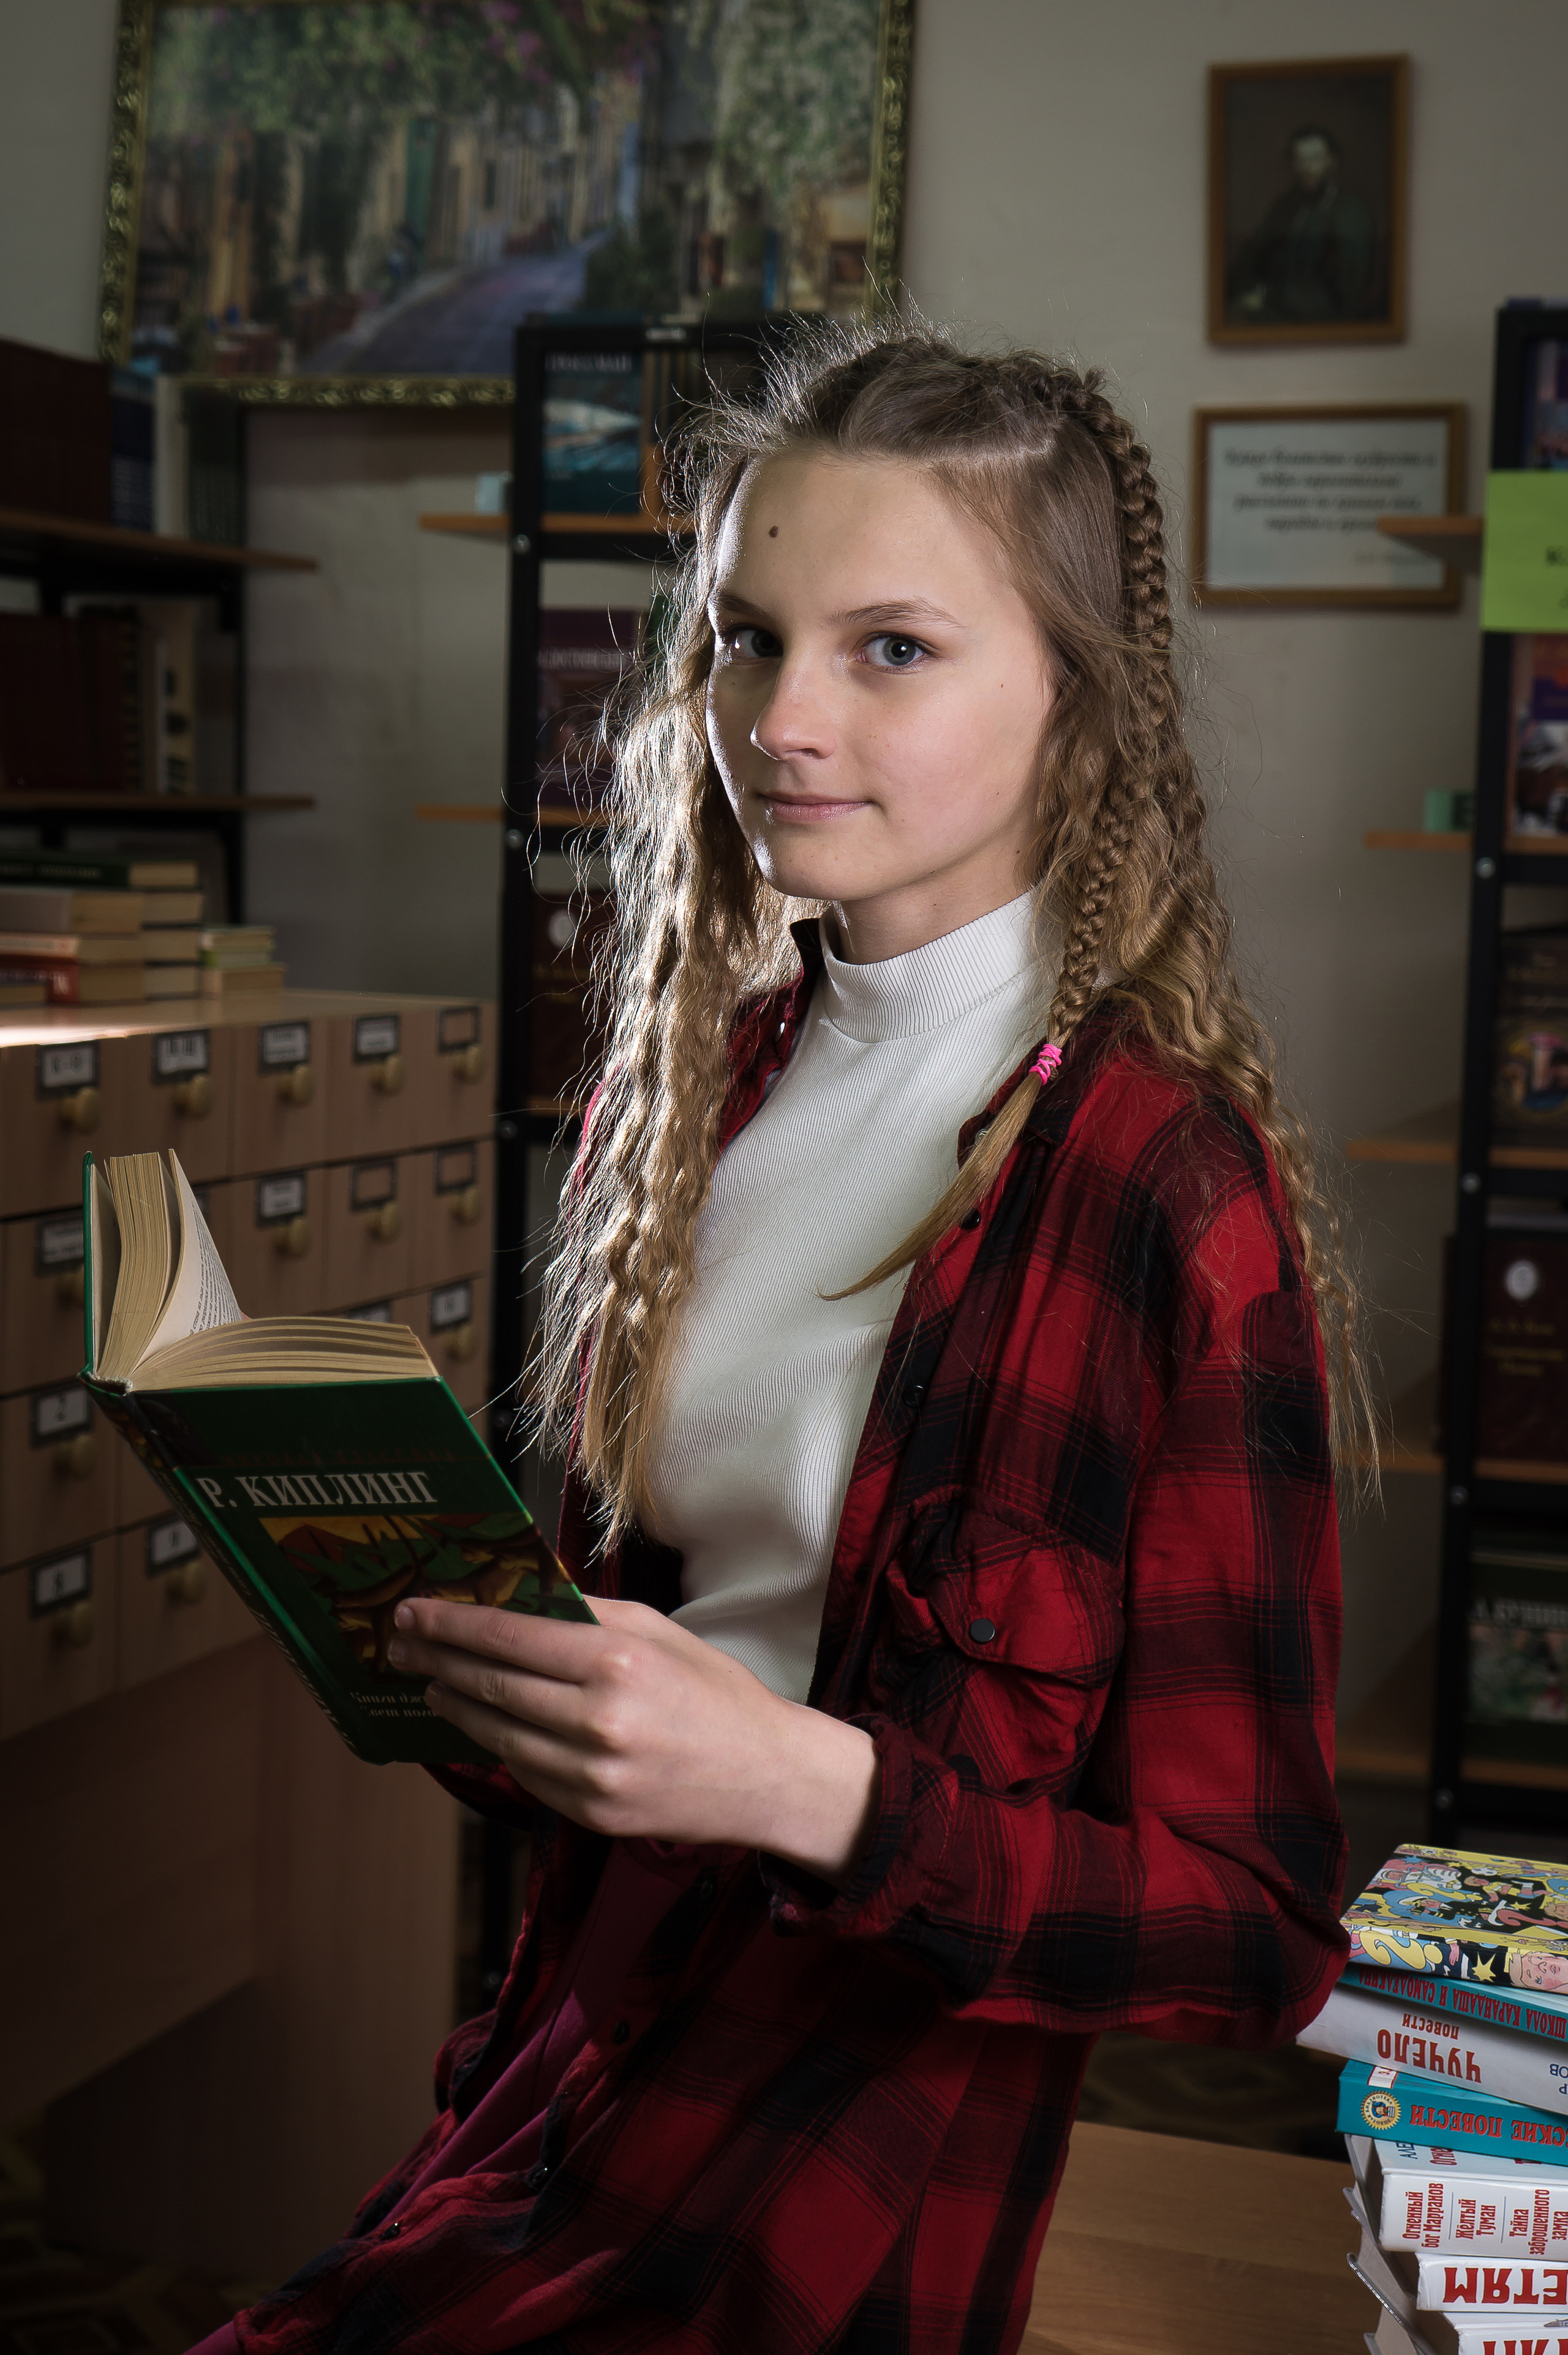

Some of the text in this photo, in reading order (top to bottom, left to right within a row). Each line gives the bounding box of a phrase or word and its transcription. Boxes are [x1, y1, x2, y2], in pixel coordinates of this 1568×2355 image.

[195, 1471, 439, 1508] Р. КИПЛИНГ
[1359, 1967, 1567, 2040] ШКОЛА КАРАНДАША И САМОДЕЛКИНА
[1377, 2029, 1482, 2084] ЧУЧЕЛО
[1410, 2105, 1502, 2138] ПОВЕСТИ
[1401, 2191, 1423, 2240] Огненный
[1421, 2183, 1444, 2248] бог Марранов
[1455, 2199, 1477, 2240] Жёлтый
[1476, 2204, 1496, 2236] Туман
[1509, 2209, 1529, 2237] Тайна
[1529, 2189, 1550, 2256] заброшенного
[1551, 2210, 1568, 2241] замка
